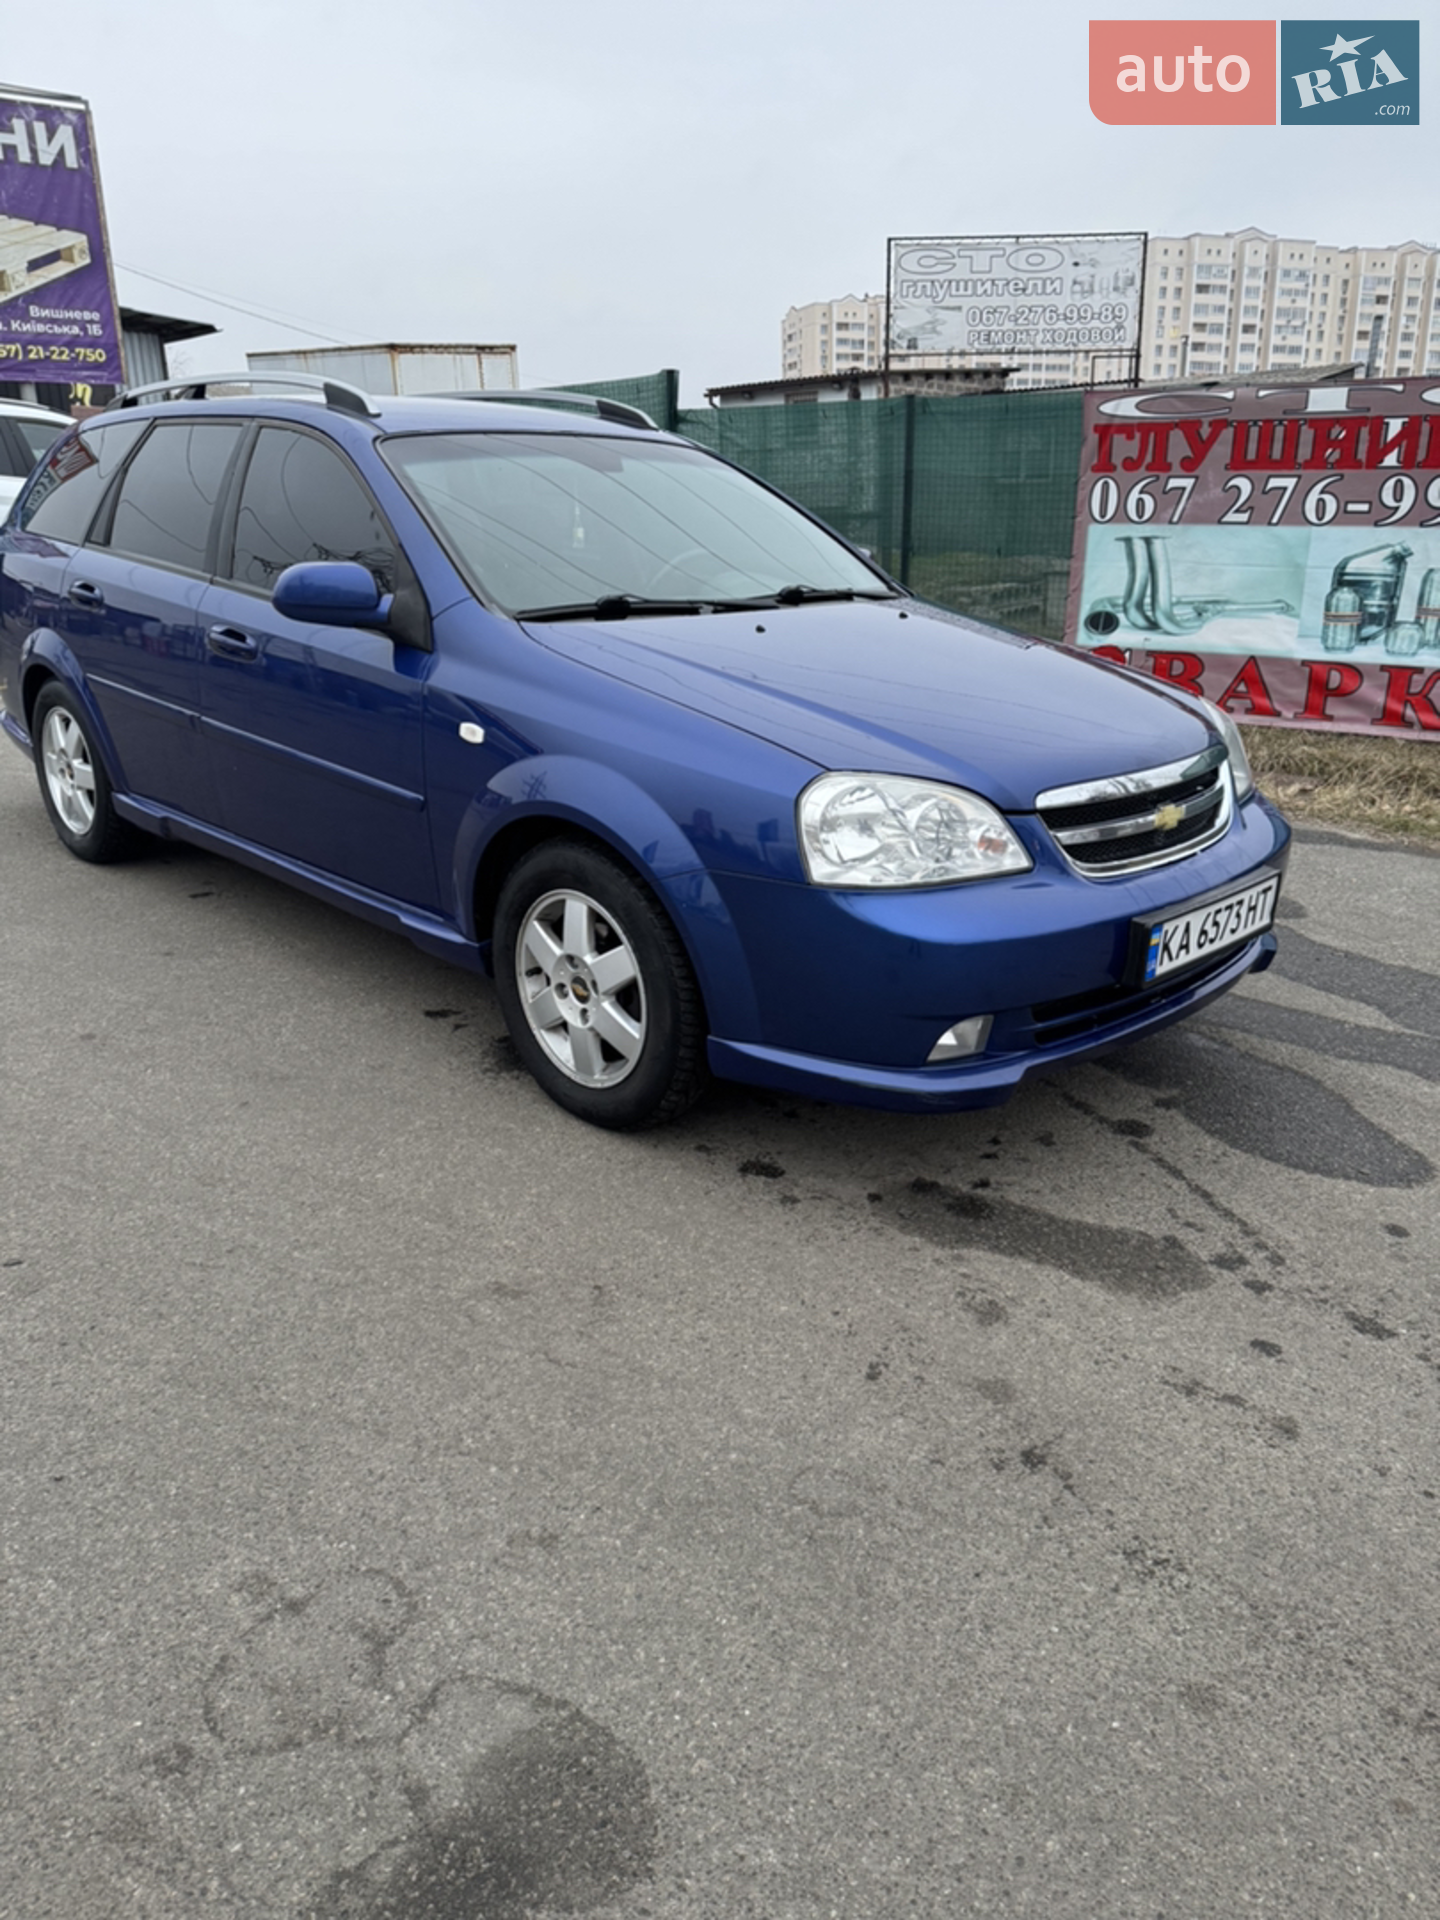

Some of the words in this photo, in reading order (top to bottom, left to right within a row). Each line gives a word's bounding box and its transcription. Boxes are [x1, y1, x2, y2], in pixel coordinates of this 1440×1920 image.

[899, 246, 1065, 275] СТО
[901, 276, 1063, 304] глушители
[29, 304, 101, 321] Вишневе
[966, 303, 1129, 327] 067-276-99-89
[10, 319, 84, 336] Київська,
[967, 328, 1038, 346] РЕМОНТ
[1040, 325, 1127, 347] ХОДОВОЙ
[27, 344, 107, 363] 21-22-750
[1098, 383, 1440, 418] СТ
[1089, 474, 1199, 525] 067
[1092, 644, 1440, 732] ВАРК
[1159, 921, 1191, 967] KA
[1196, 898, 1245, 950] 6573
[1244, 885, 1273, 929] HT
